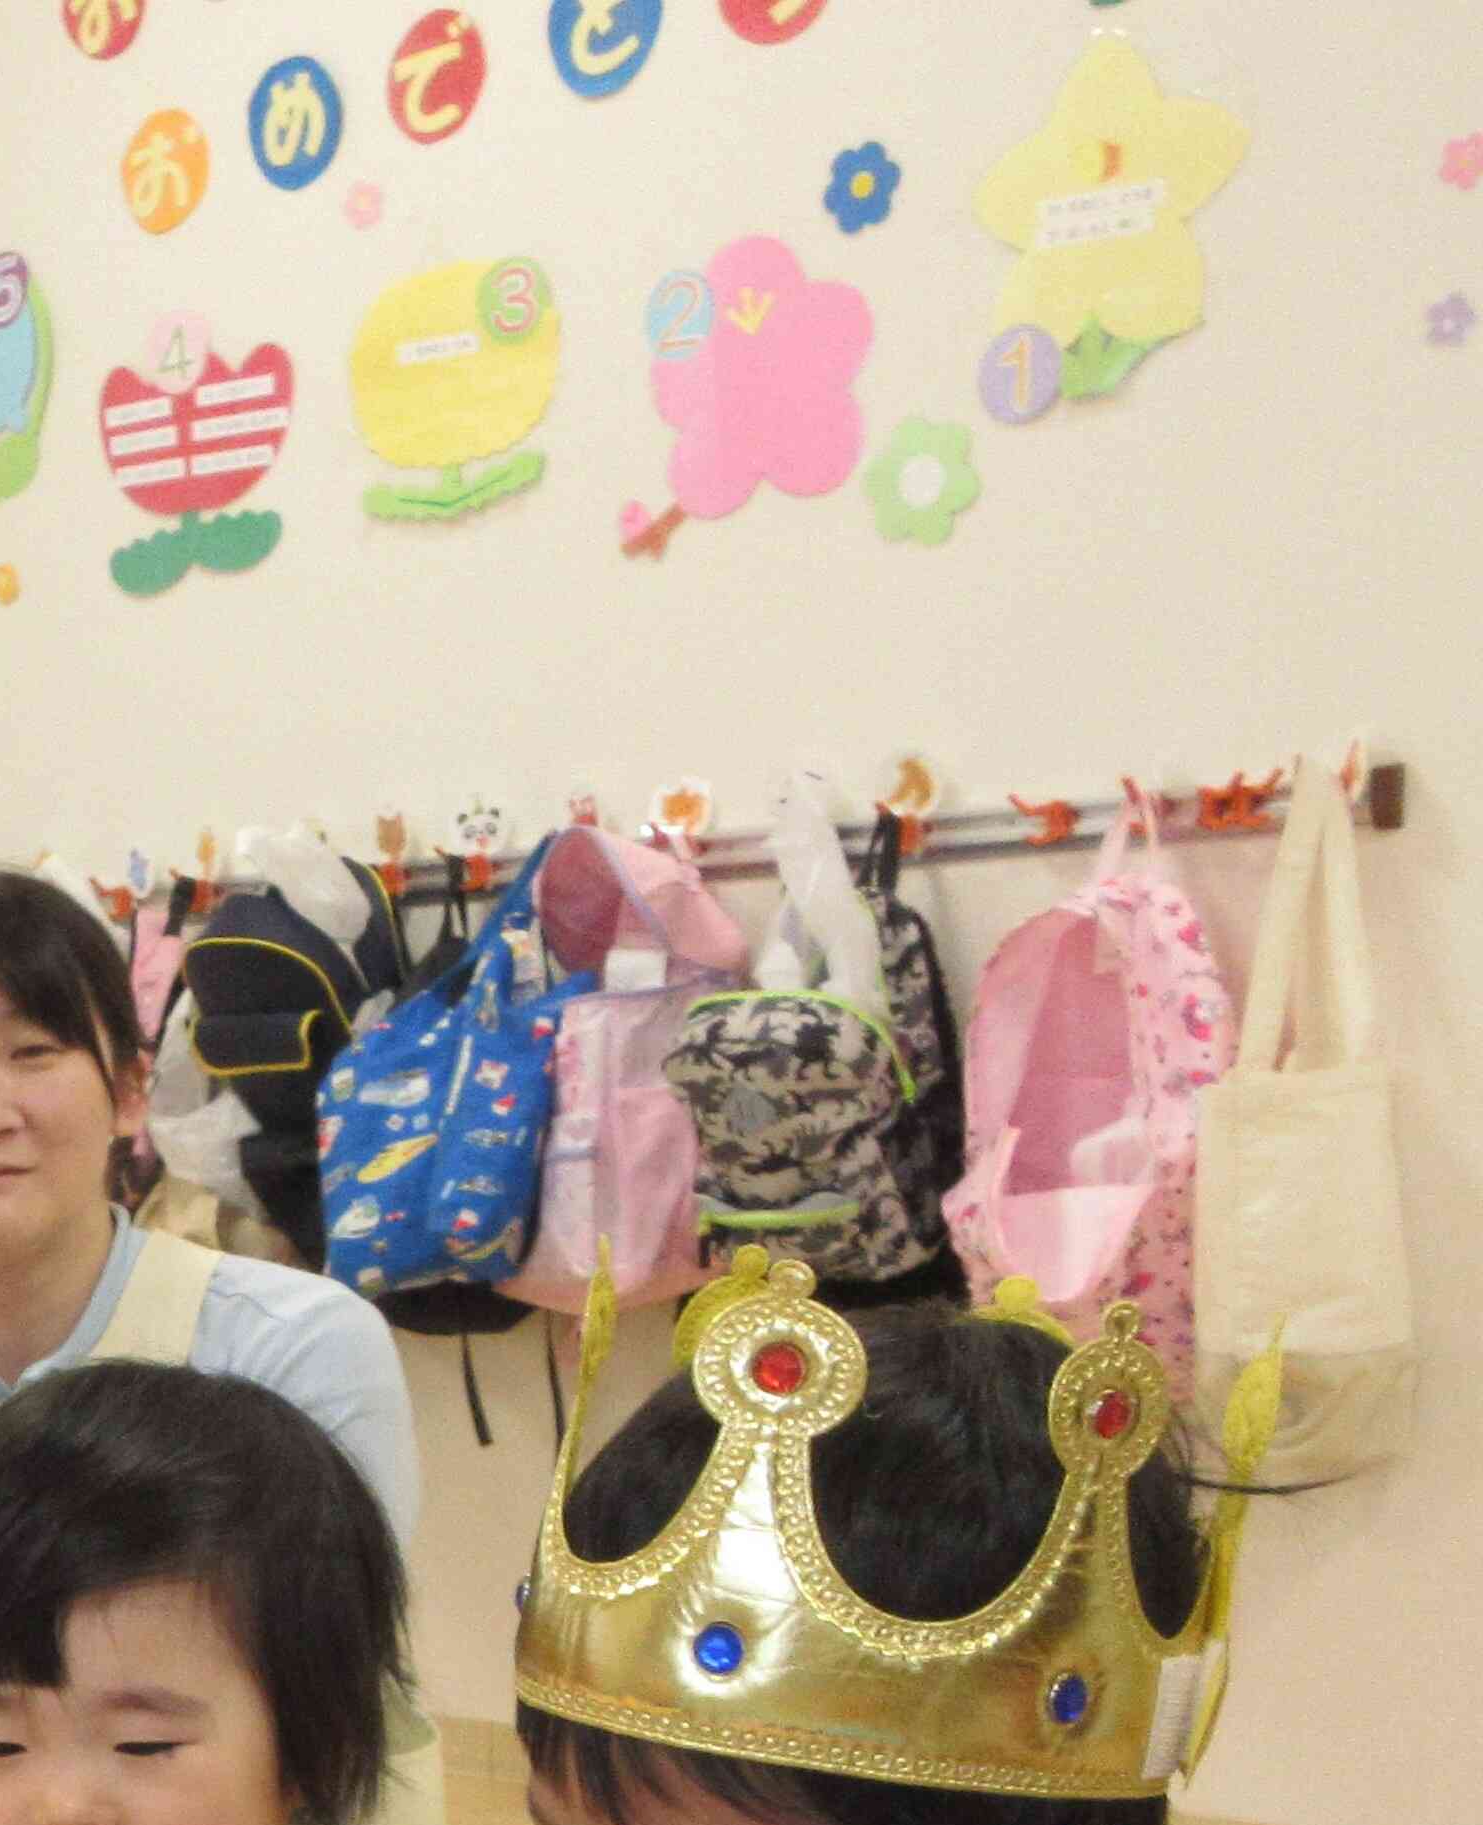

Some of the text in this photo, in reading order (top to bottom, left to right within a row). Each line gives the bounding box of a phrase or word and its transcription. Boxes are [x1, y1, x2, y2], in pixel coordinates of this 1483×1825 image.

[489, 266, 538, 335] 3
[655, 279, 701, 353] 2
[156, 324, 197, 380] 4
[997, 332, 1032, 413] 1
